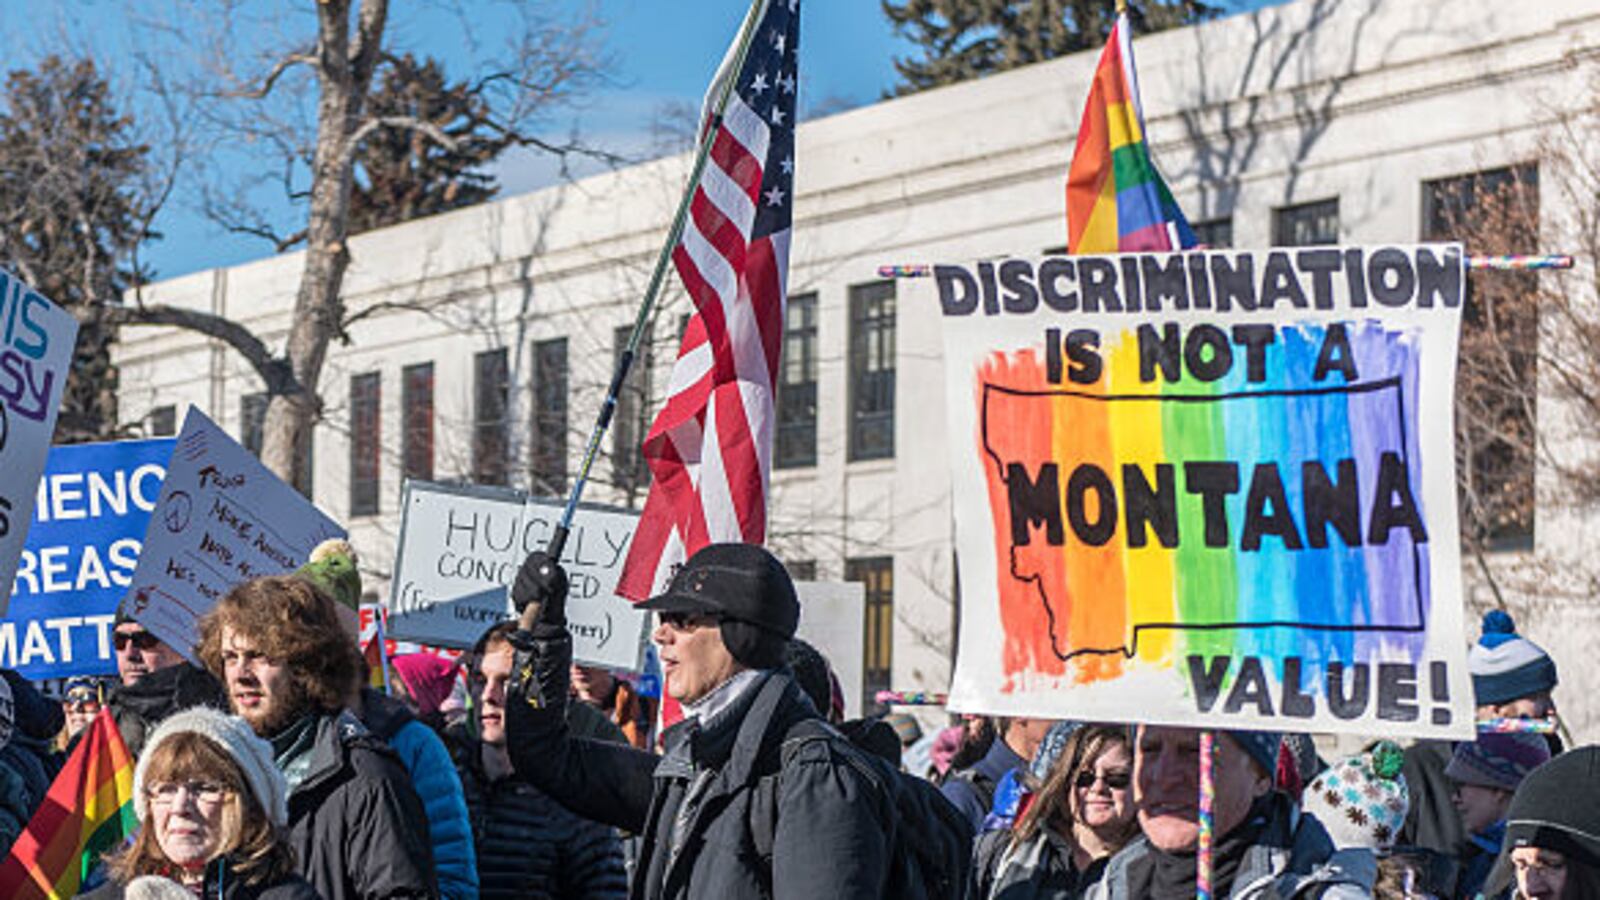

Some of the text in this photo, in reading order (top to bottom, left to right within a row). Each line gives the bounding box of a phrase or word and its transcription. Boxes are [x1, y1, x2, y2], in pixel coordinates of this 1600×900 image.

[934, 246, 1461, 316] DISCRIMINATION
[1045, 322, 1360, 384] IS NOT A
[1007, 451, 1428, 552] MONTANA
[437, 551, 601, 600] CONCED
[1187, 655, 1453, 727] VALUE!
